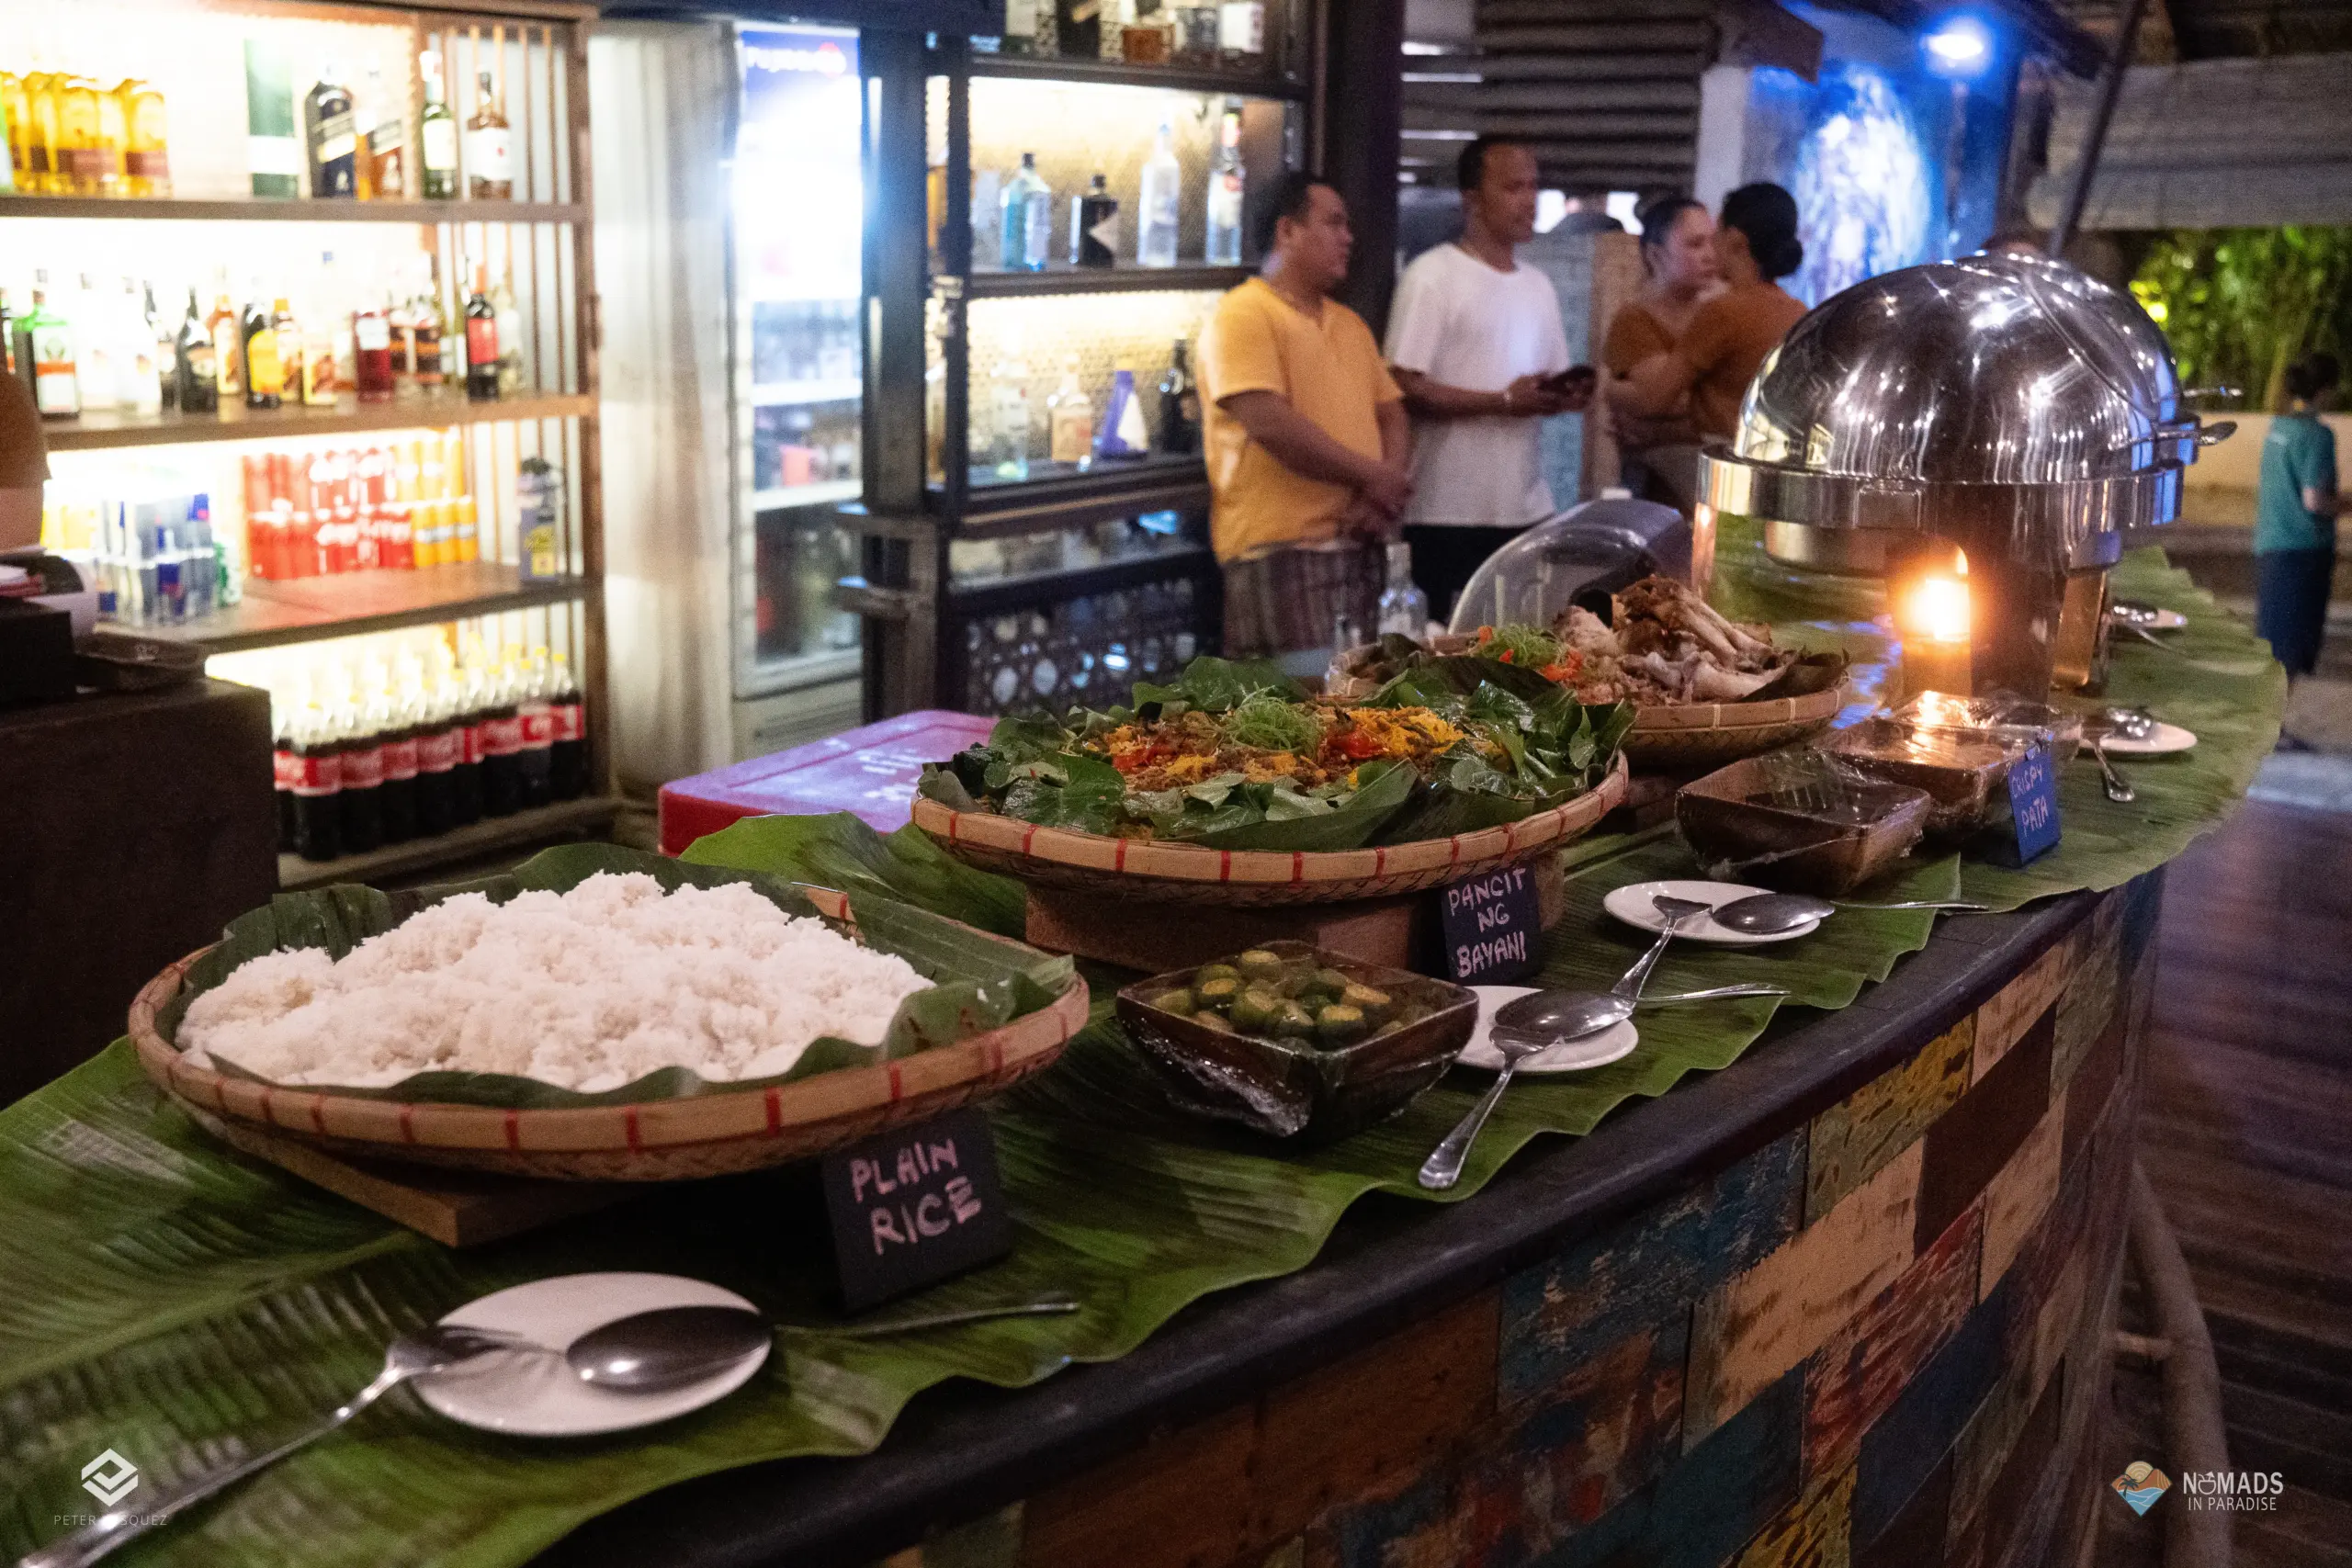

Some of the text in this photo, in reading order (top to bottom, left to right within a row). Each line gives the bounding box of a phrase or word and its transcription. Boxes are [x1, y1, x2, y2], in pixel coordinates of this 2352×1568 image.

[2011, 763, 2043, 798] CRISPY
[2021, 795, 2049, 837] PATA
[1448, 867, 1526, 917] PANCIT
[1477, 902, 1510, 932] NG
[1456, 931, 1527, 978] BAYANI
[849, 1138, 959, 1203] PLAIN
[870, 1175, 982, 1256] RICE
